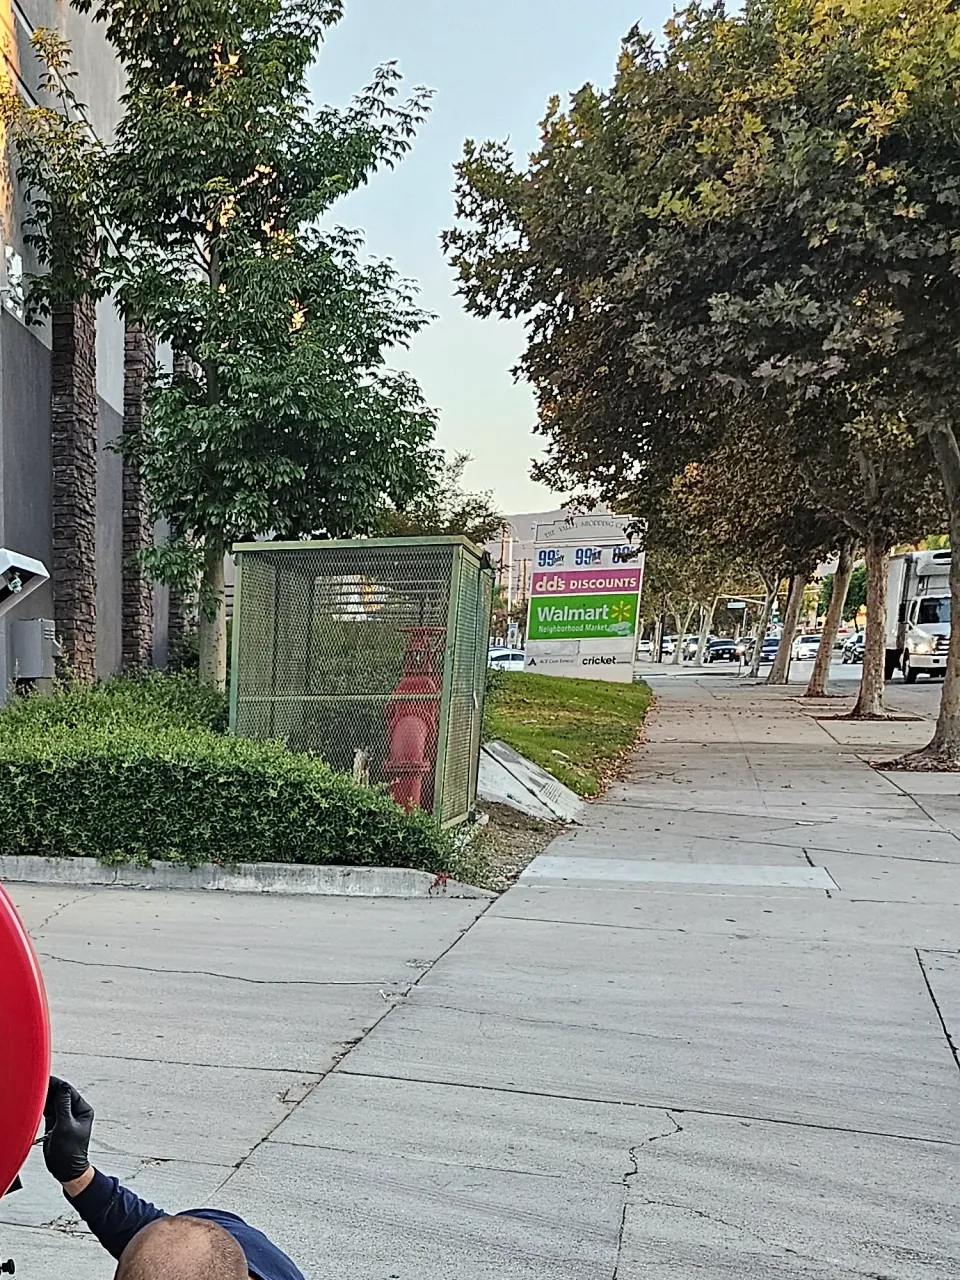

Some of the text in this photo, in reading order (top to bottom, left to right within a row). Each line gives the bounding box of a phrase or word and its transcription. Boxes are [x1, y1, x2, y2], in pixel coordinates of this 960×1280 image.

[536, 576, 636, 592] dd's DISCOUNTS
[538, 604, 608, 622] Walmart
[538, 624, 583, 634] Neighborhood
[582, 656, 616, 665] cricket
